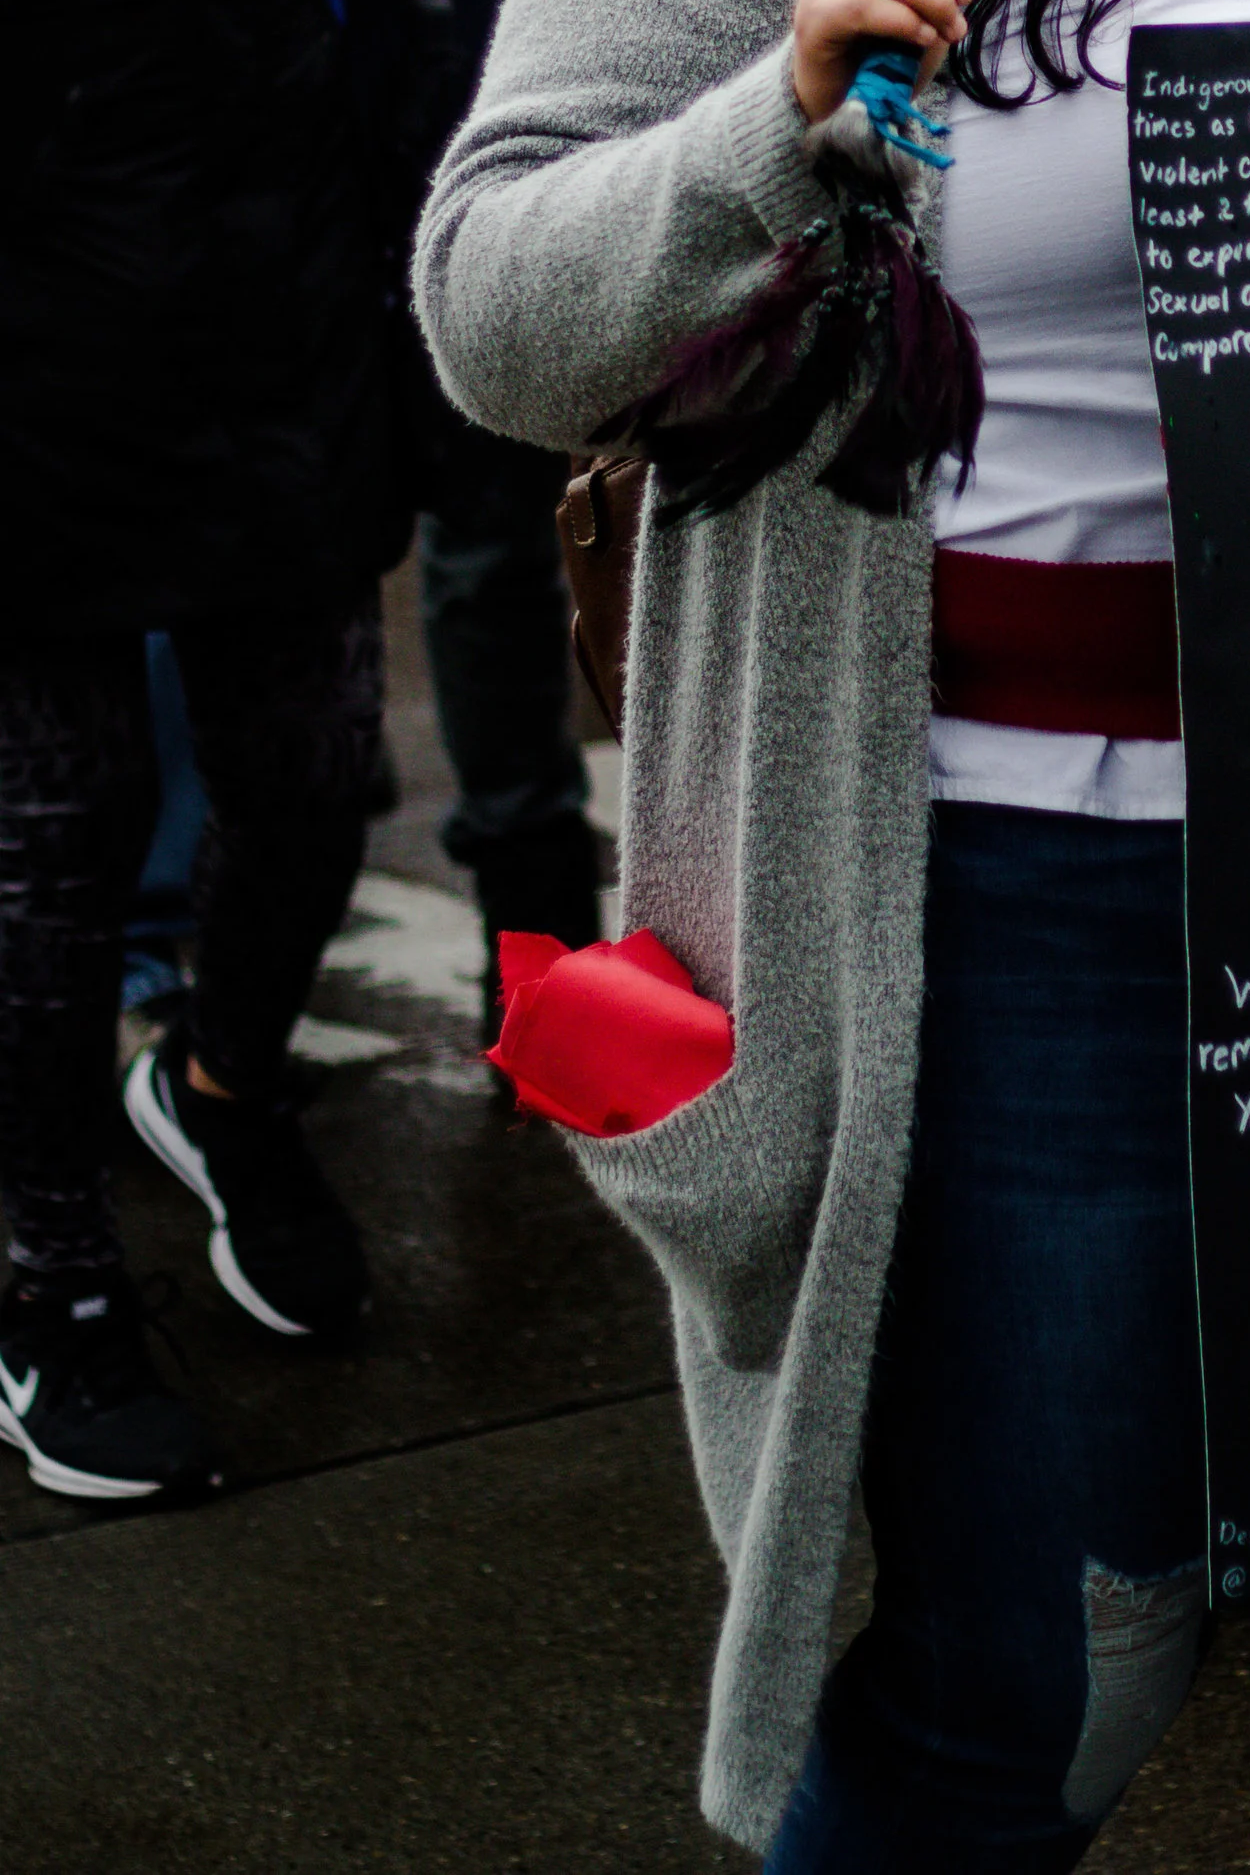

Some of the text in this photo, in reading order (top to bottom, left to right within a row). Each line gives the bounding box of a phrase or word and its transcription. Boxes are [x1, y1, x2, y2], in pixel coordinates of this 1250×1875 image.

[1132, 108, 1196, 139] times
[1209, 116, 1236, 137] as
[1139, 197, 1206, 228] least
[1217, 196, 1235, 222] 2
[1145, 238, 1173, 270] to
[1146, 285, 1230, 316] Sexual
